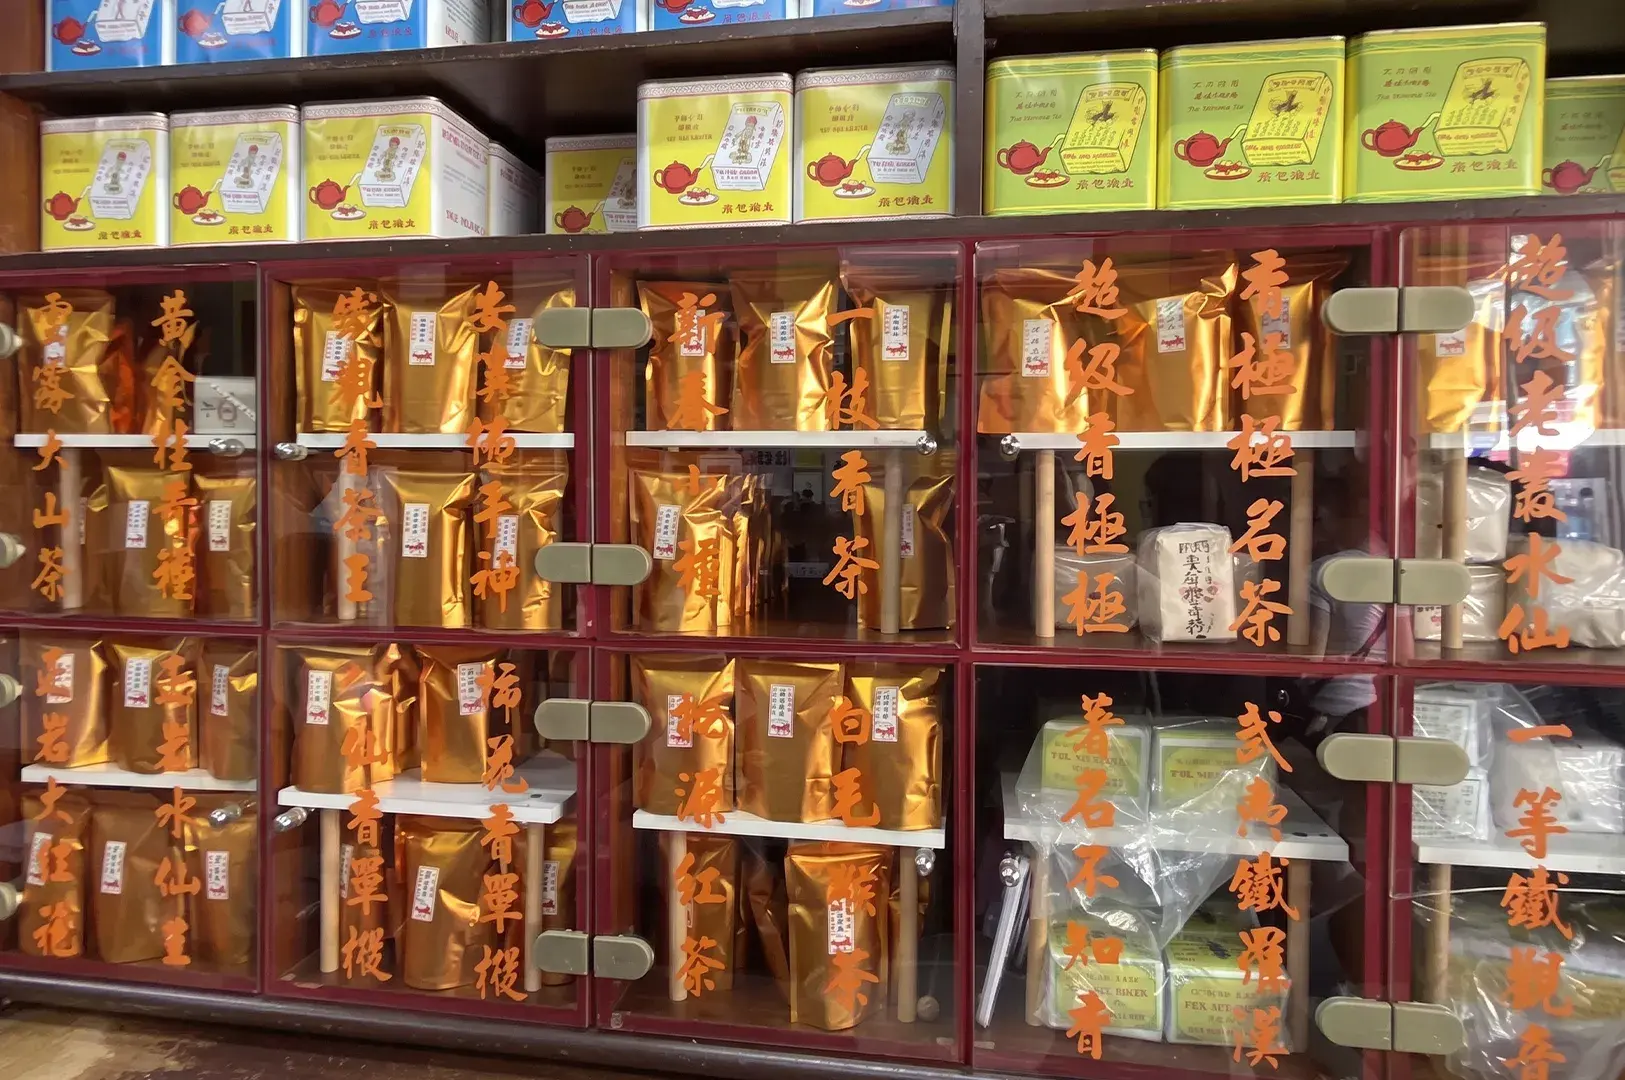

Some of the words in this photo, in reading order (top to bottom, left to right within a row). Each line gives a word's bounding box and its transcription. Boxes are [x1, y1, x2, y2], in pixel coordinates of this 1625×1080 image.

[823, 306, 880, 600] 一枝香茶
[1061, 256, 1136, 637] 超級香極極
[1226, 248, 1299, 648] 香極極名茶
[1061, 691, 1125, 1060] 著名不知香
